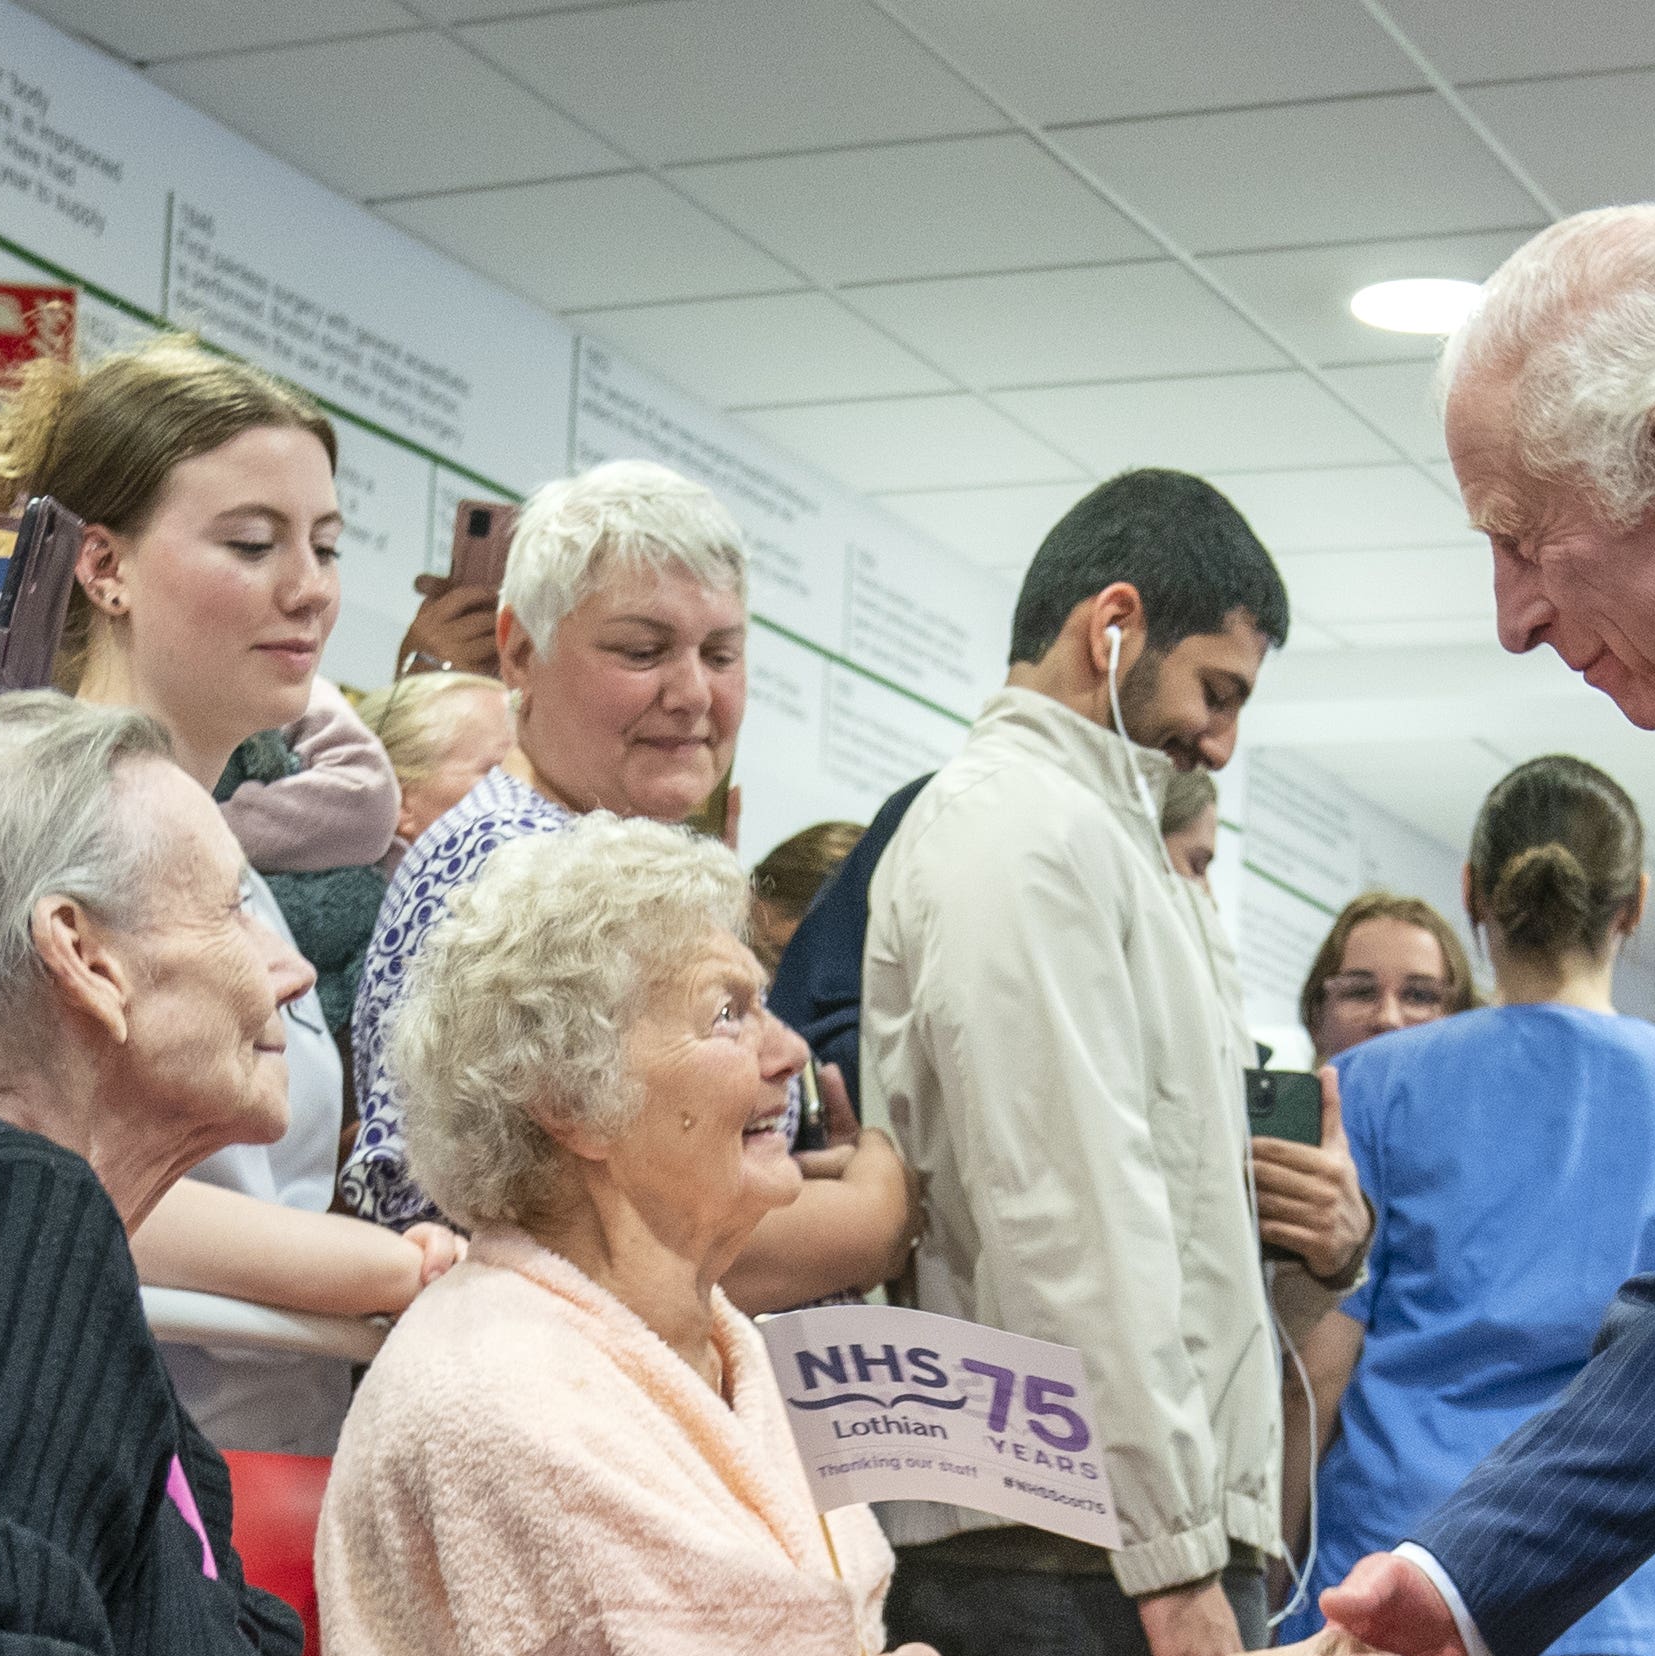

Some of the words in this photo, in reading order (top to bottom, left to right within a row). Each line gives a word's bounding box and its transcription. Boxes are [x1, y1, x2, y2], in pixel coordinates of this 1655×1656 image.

[795, 1343, 948, 1391] NHS
[962, 1357, 1090, 1452] 75
[832, 1413, 948, 1440] Lothian
[816, 1456, 900, 1478] Thanking
[905, 1456, 932, 1470] our
[938, 1461, 978, 1478] staff
[988, 1436, 1098, 1480] YEARS
